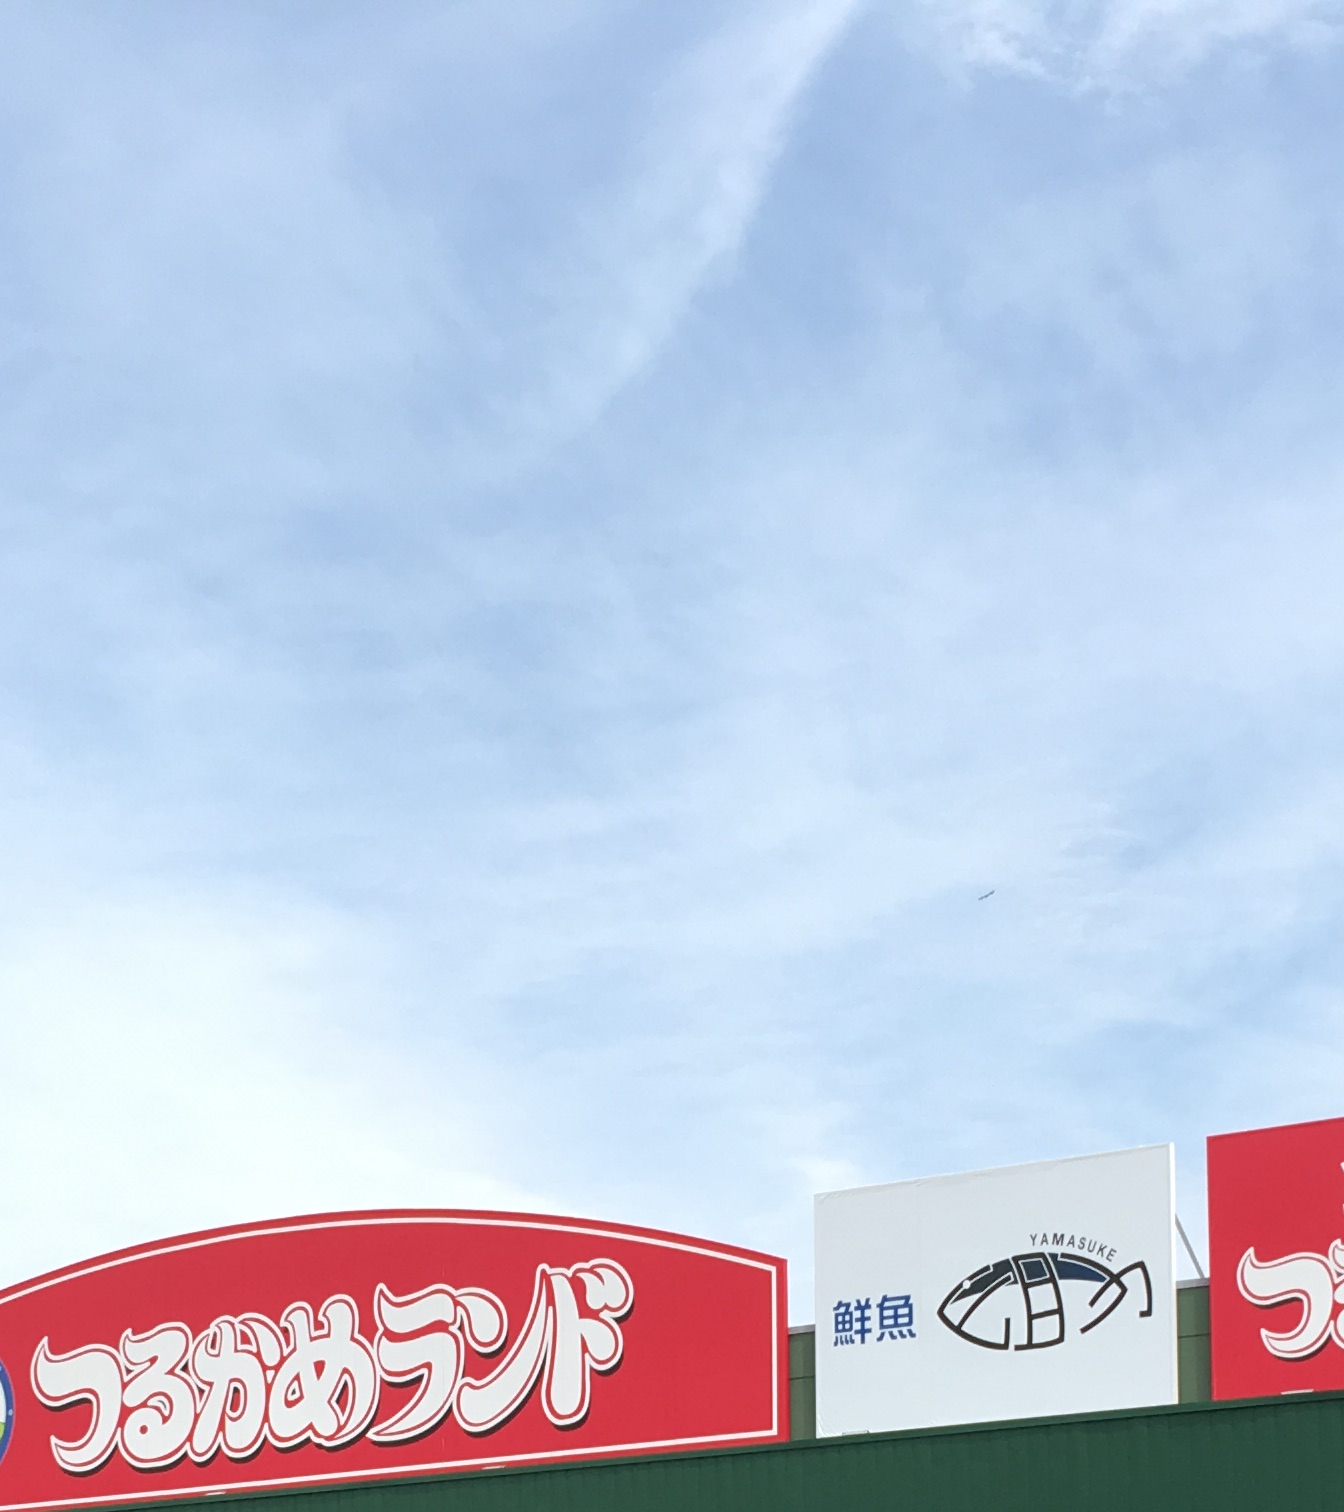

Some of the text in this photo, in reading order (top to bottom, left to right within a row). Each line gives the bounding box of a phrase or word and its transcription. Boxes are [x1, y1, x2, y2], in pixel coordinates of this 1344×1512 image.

[1029, 1232, 1117, 1262] YAMASUKE
[833, 1294, 916, 1347] 鮮魚
[30, 1257, 633, 1474] つるかめランド
